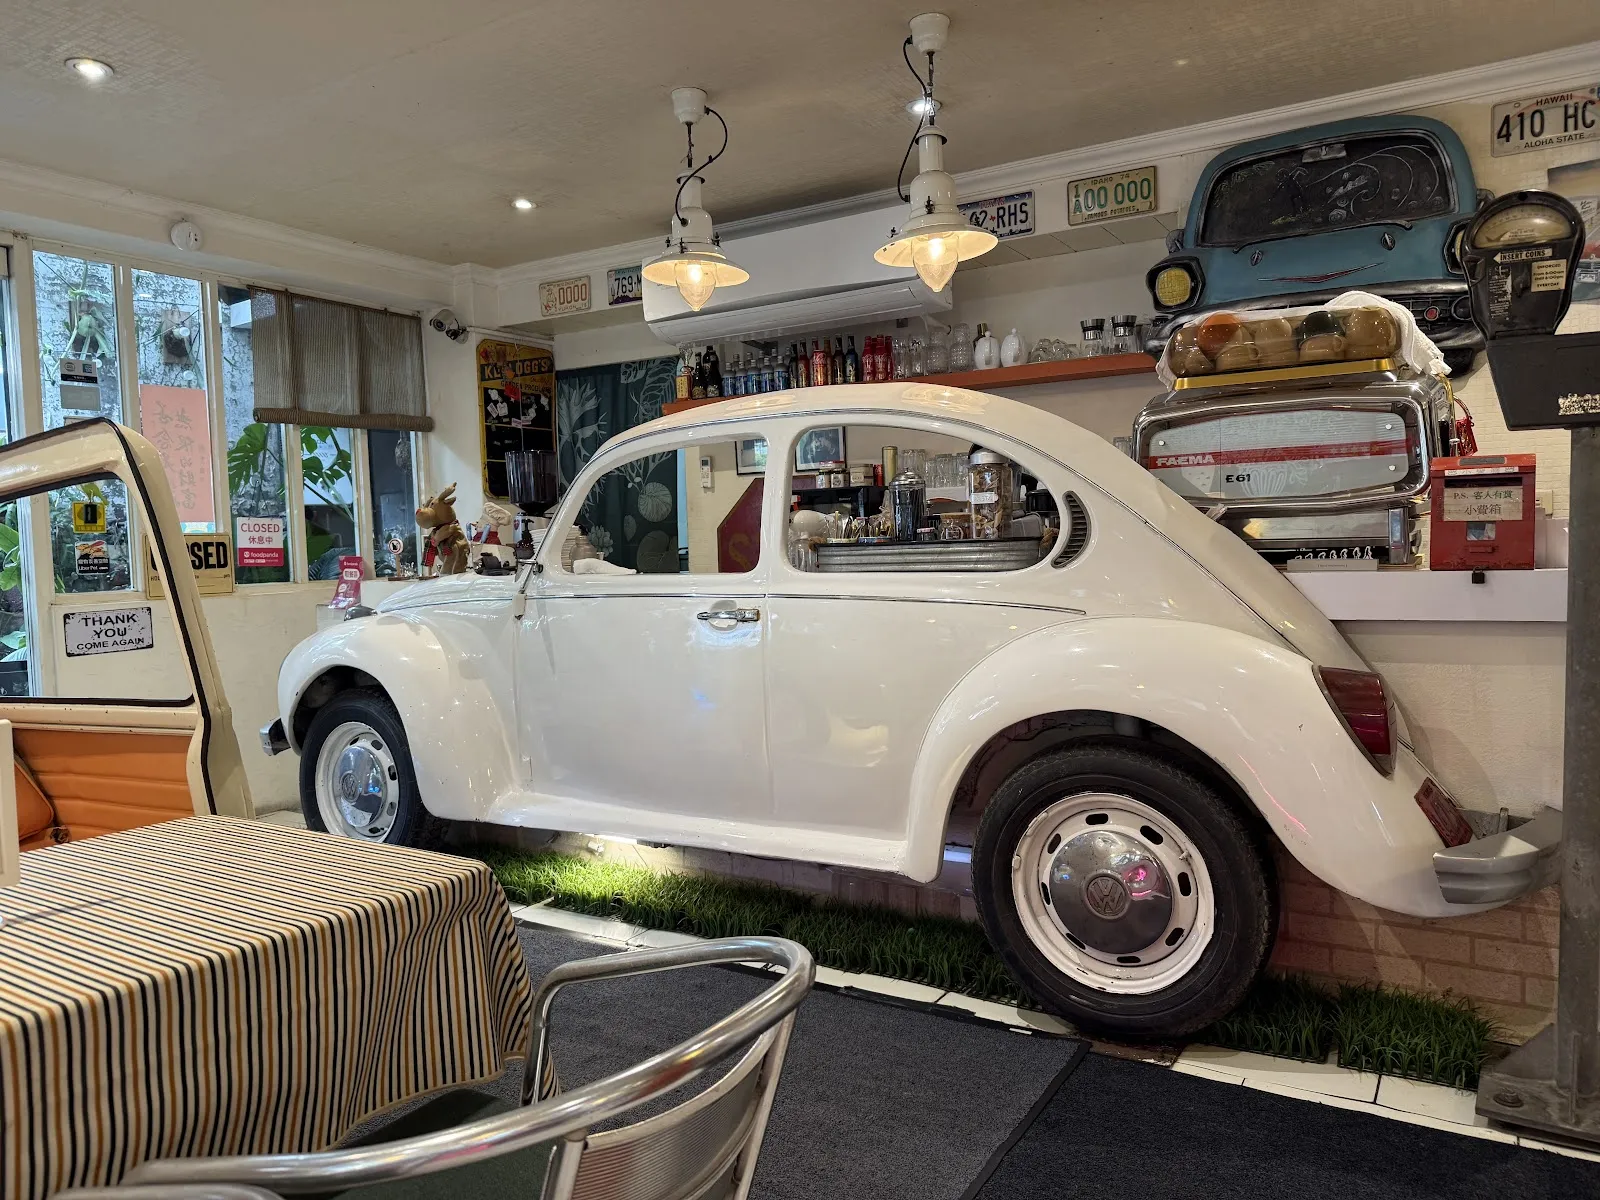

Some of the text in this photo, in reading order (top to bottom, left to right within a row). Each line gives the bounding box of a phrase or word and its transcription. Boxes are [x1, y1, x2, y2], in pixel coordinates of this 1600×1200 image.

[1536, 93, 1573, 106] HAWAII
[1497, 109, 1545, 143] 410
[1524, 132, 1585, 149] ALOHA STATE
[1091, 176, 1113, 186] IDAHO
[996, 202, 1029, 229] RHS
[1087, 206, 1136, 220] FAMOUS POTATOES
[1500, 249, 1546, 261] INSERT COINS
[558, 283, 587, 305] 0000
[1156, 454, 1215, 467] FAEMA
[1453, 492, 1469, 500] P.S.
[241, 523, 280, 533] CLOSED
[248, 535, 273, 545] 休息中
[81, 613, 138, 627] THANK
[93, 627, 127, 639] YOU
[76, 637, 145, 650] COME AGAIN
